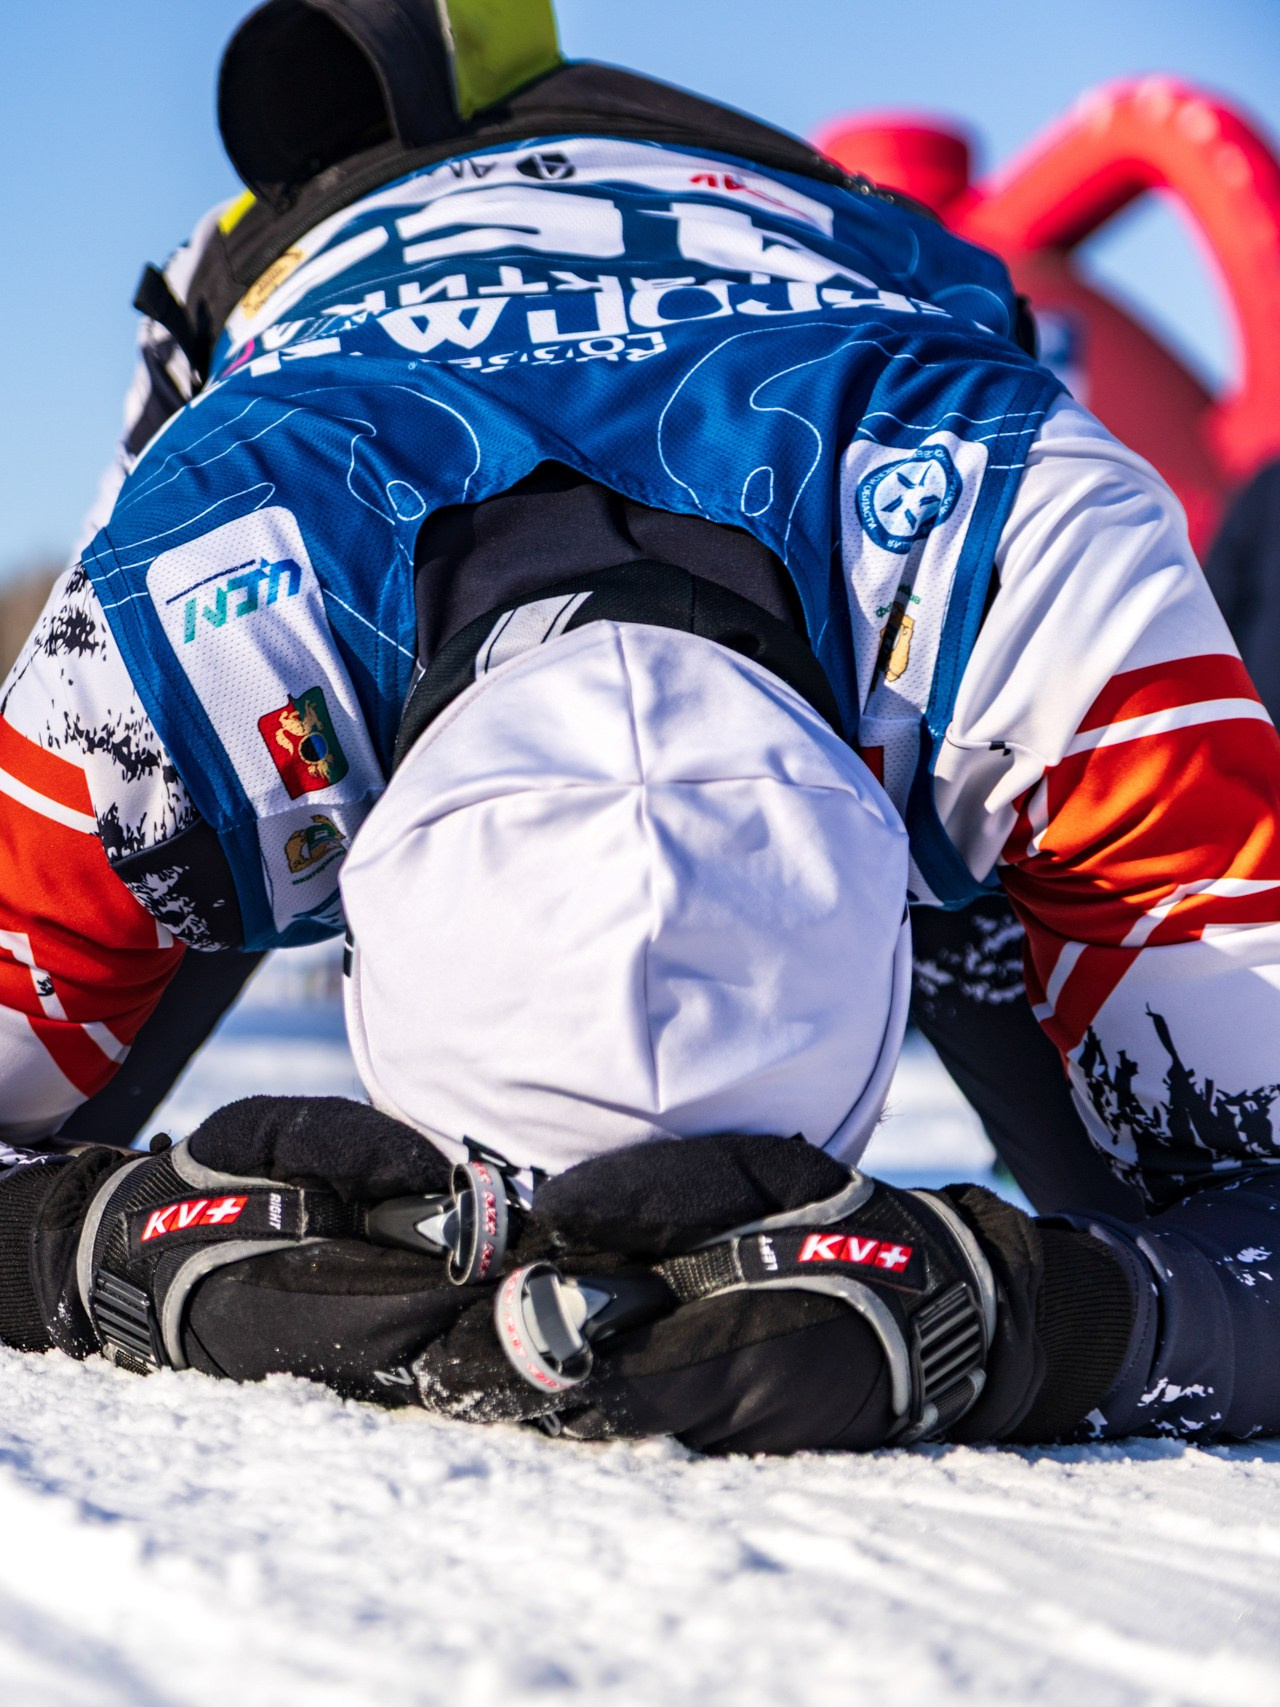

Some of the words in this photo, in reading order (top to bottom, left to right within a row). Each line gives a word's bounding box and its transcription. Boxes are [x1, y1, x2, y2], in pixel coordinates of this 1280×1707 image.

[141, 1197, 242, 1242] KV+
[268, 1192, 282, 1231] RIGHT
[758, 1234, 779, 1271] LEFT
[800, 1234, 909, 1269] KV+
